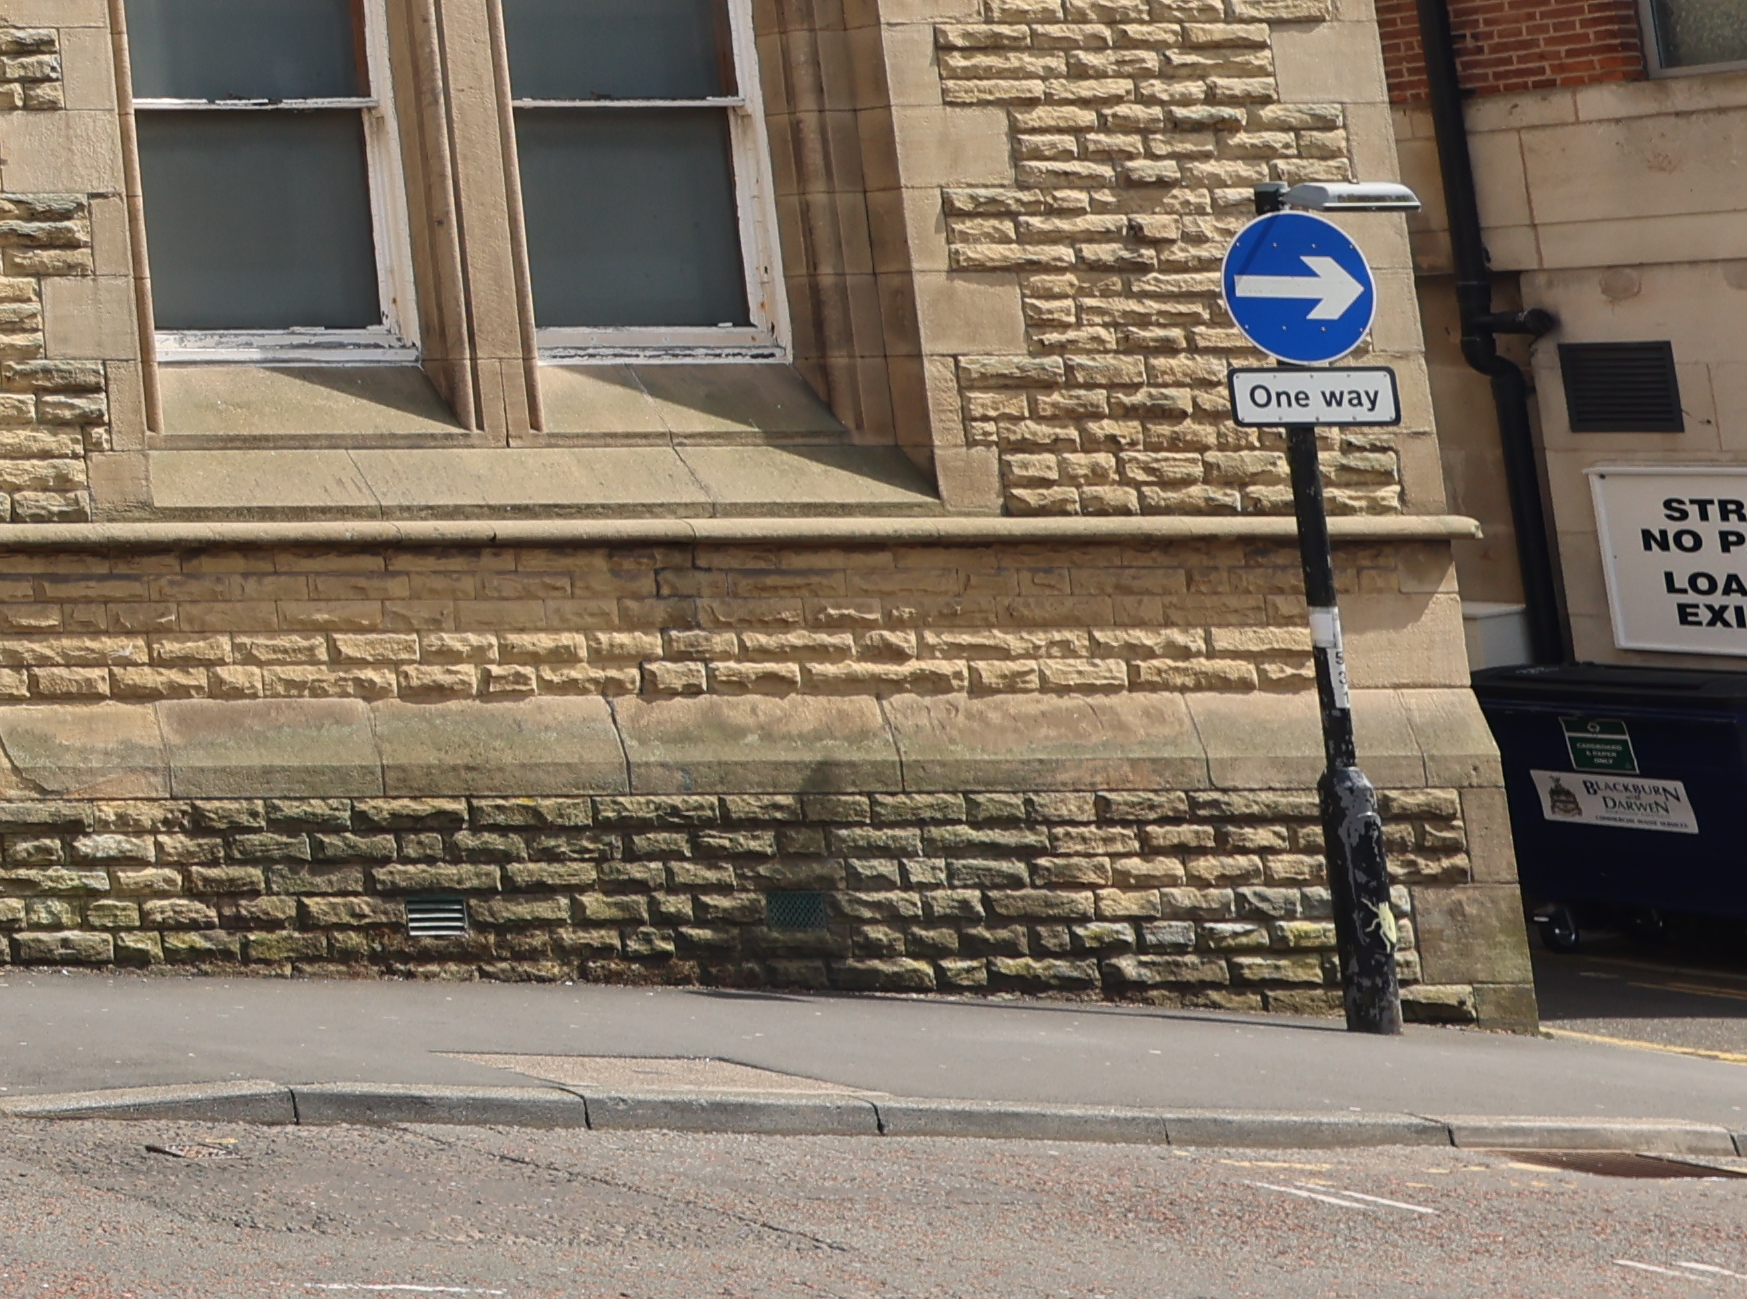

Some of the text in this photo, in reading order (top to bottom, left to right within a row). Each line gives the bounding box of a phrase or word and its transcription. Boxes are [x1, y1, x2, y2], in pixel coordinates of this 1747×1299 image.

[1249, 385, 1379, 412] One way
[1663, 498, 1747, 522] STR
[1641, 528, 1703, 553] NO
[1664, 571, 1747, 596] LOA
[1582, 780, 1681, 803] BLACKBURN
[1602, 796, 1670, 814] DARWEN
